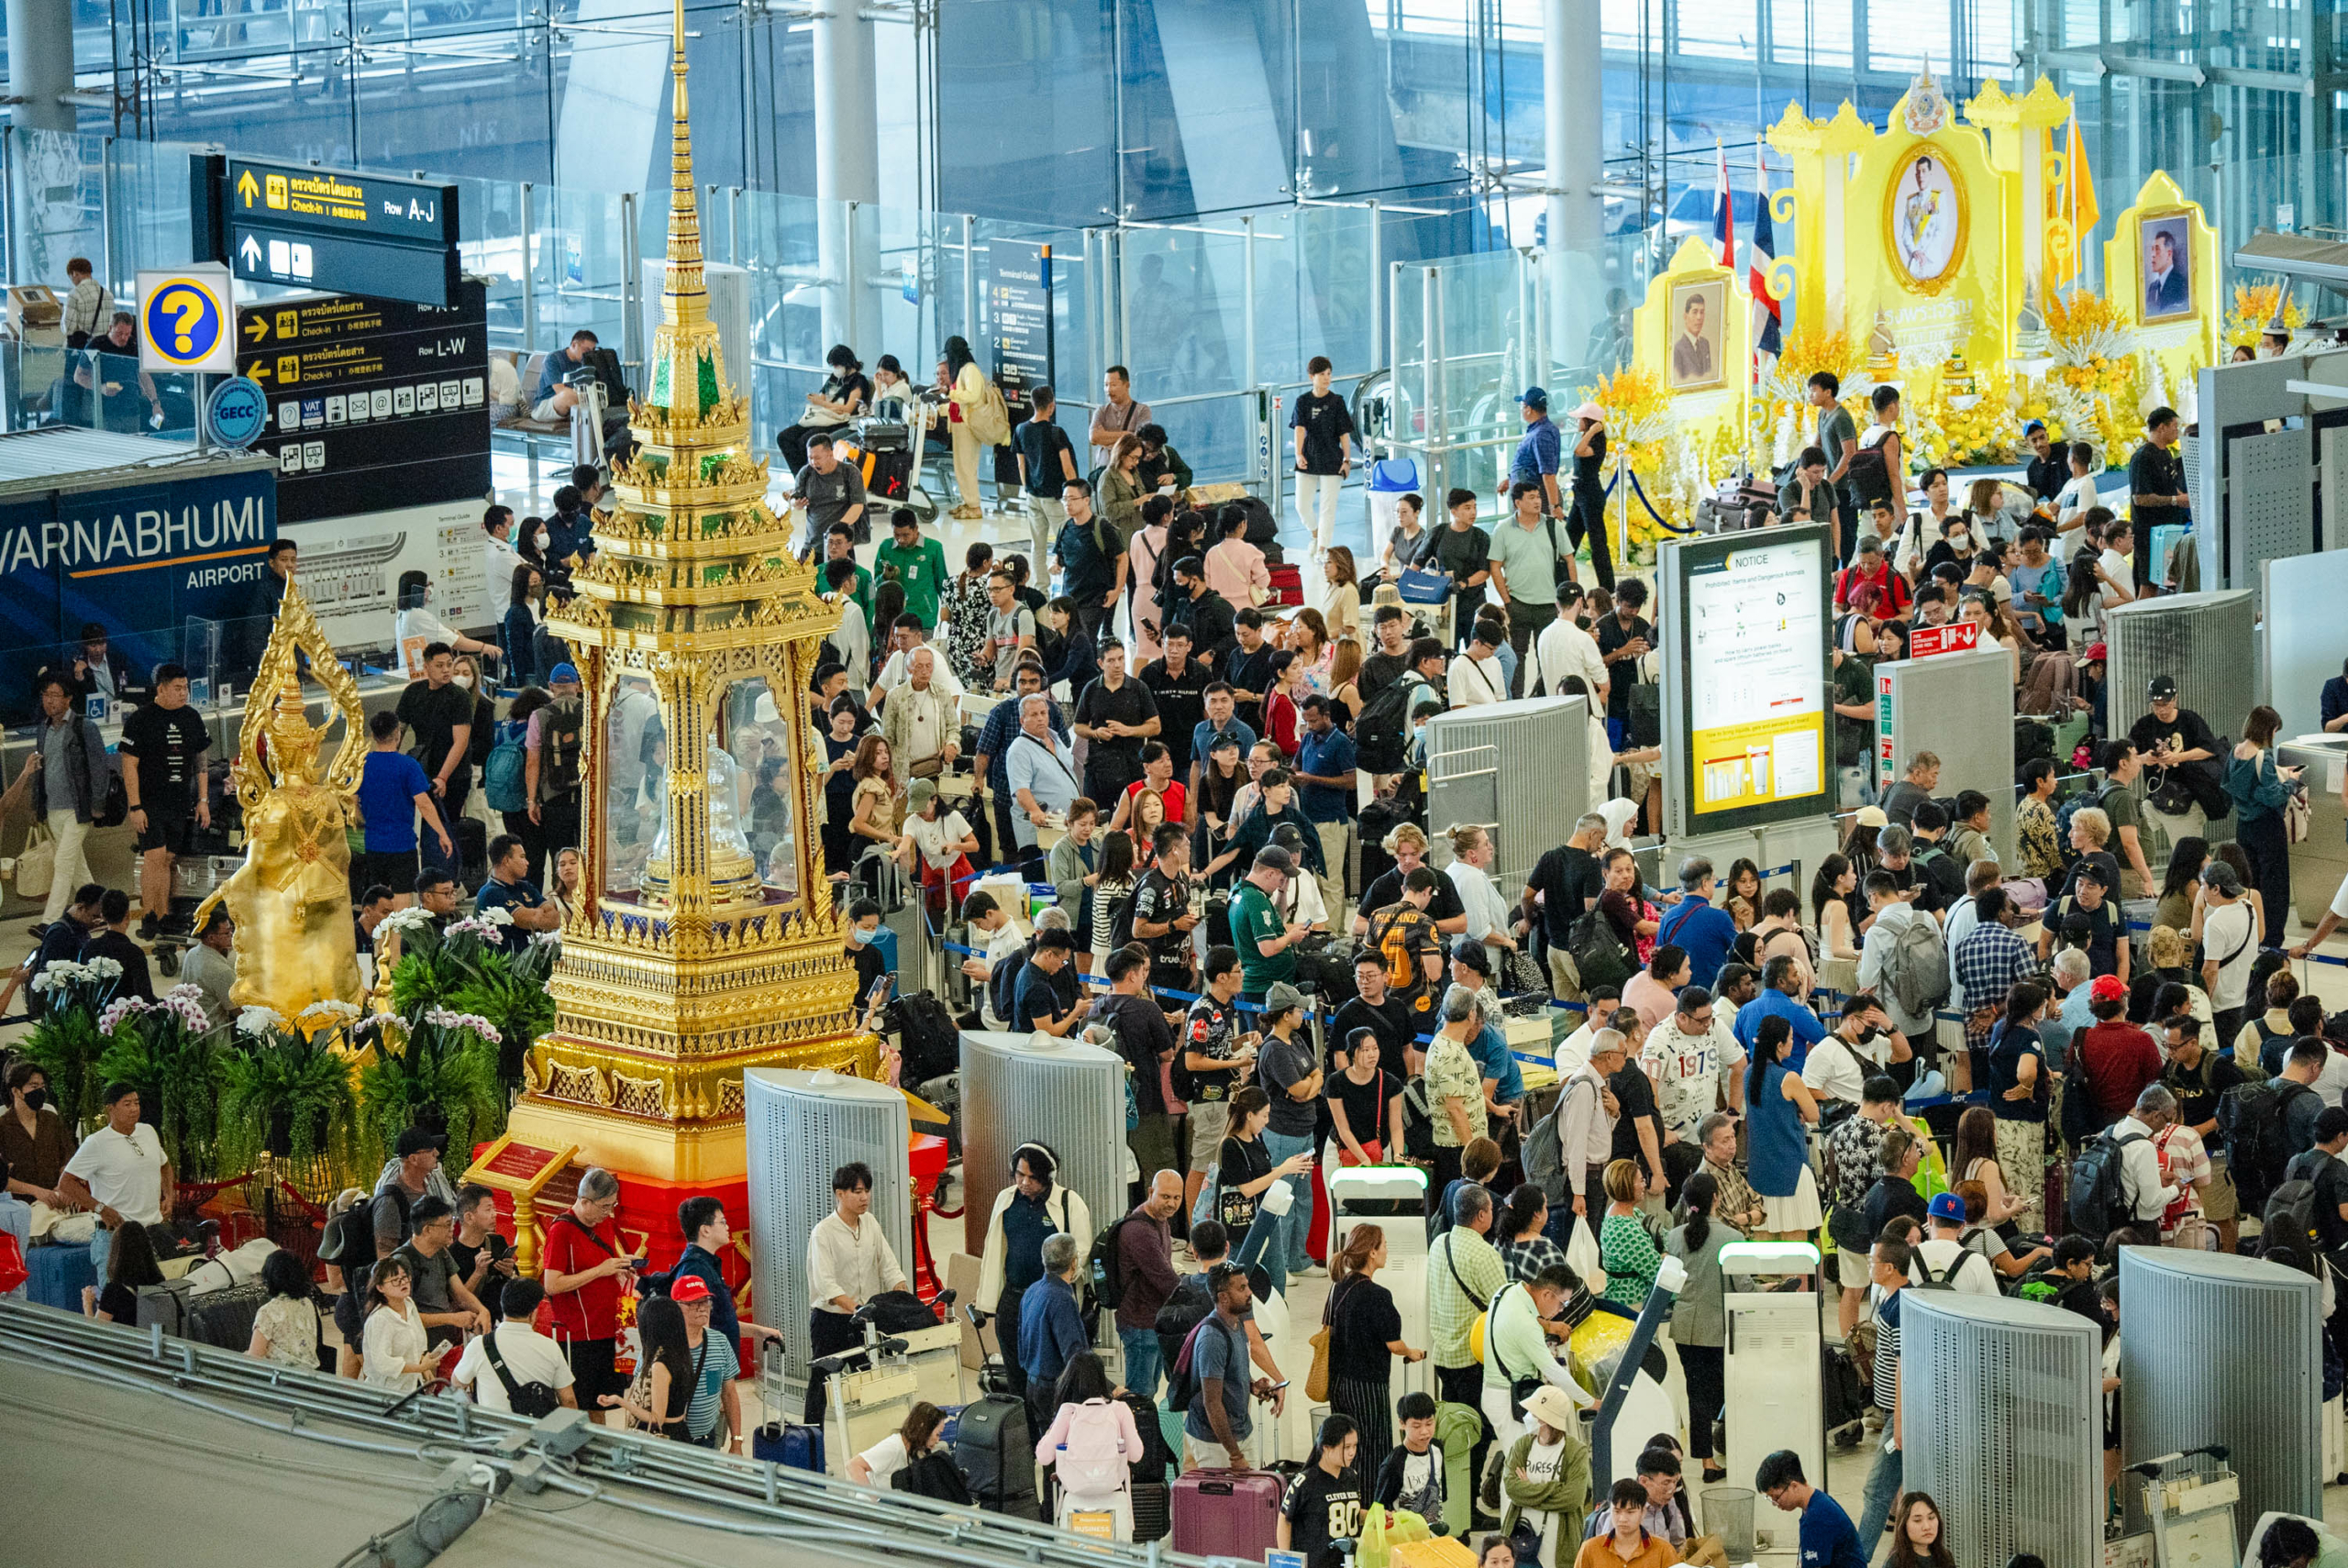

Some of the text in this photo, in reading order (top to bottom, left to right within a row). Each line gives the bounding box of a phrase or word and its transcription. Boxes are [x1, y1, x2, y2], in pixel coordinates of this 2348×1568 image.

[292, 199, 323, 215] Check-in
[383, 198, 434, 222] Row A-J
[999, 268, 1022, 279] Terminal
[993, 312, 1000, 324] 3
[302, 326, 332, 337] Check-in
[418, 337, 466, 357] Row L-W
[993, 337, 1001, 348] 2
[995, 362, 1000, 373] 1
[303, 370, 333, 381] Check-in
[304, 400, 321, 412] VAT
[220, 405, 254, 419] GECC
[1735, 554, 1768, 569] NOTICE
[187, 562, 265, 590] AIRPORT
[1768, 867, 1781, 876] AOT
[1376, 913, 1419, 924] THAAND
[1159, 955, 1180, 964] true
[1157, 988, 1168, 996] AOT
[1523, 1055, 1536, 1064] AOT
[1678, 1048, 1718, 1078] 1979
[1951, 1095, 1967, 1103] AOT
[1328, 1500, 1361, 1539] 80
